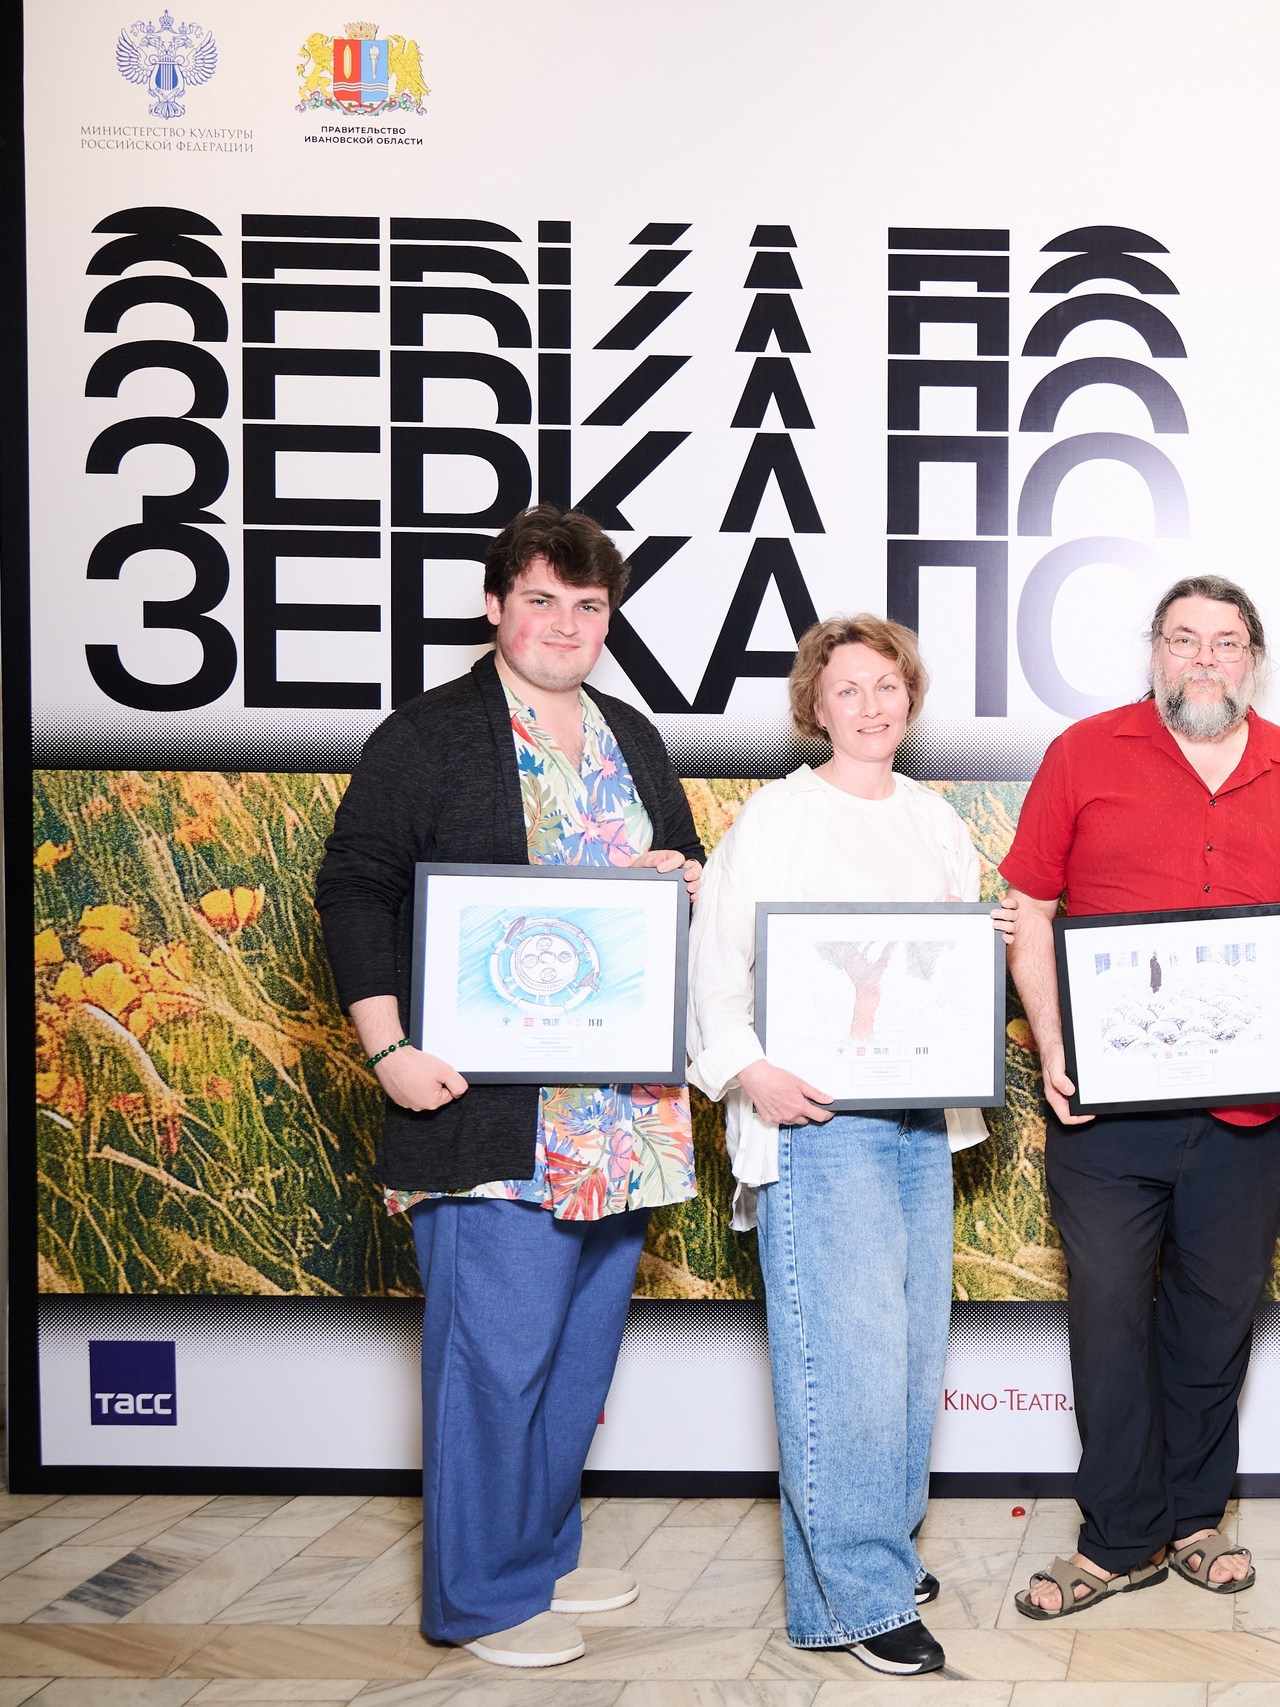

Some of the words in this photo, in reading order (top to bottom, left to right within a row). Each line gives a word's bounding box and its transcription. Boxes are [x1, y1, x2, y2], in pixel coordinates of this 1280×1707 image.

[80, 126, 186, 137] МИНИСТЕРСТВО
[190, 128, 254, 139] КУЛЬТУРЫ
[321, 126, 406, 135] ПРАВИТЕЛЬСТВО
[80, 138, 172, 150] РОССИЙСКОЙ
[176, 141, 254, 153] ФЕДЕРАЦИИ
[304, 134, 374, 145] ИВАНОВСКОЙ
[376, 137, 423, 146] ОБЛАСТИ
